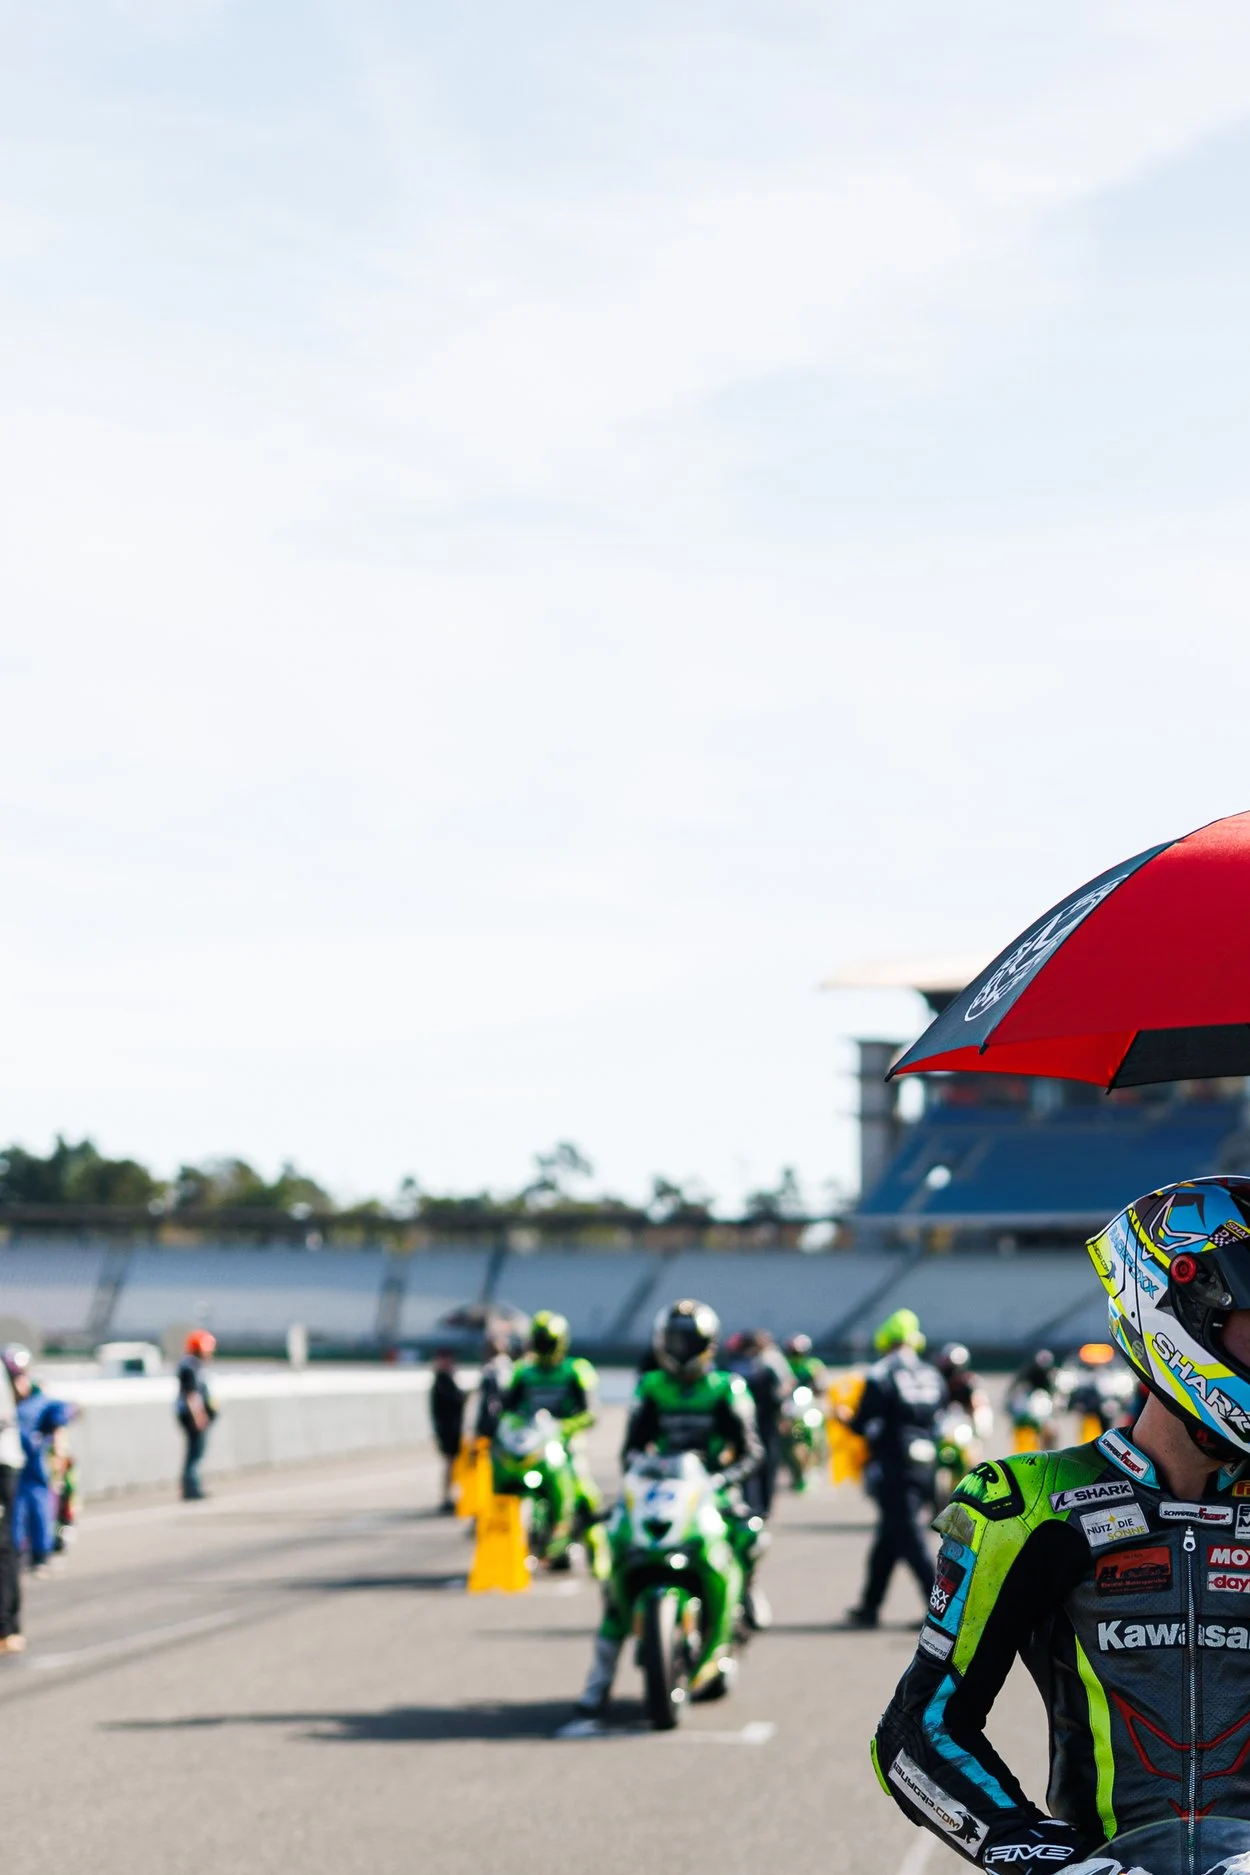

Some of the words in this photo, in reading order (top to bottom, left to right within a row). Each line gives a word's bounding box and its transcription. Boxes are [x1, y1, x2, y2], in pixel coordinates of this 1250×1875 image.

[1074, 1484, 1132, 1501] SHARK
[1087, 1524, 1111, 1536] NUTZ
[1118, 1518, 1134, 1529] DIE
[1107, 1527, 1145, 1541] SONNE
[984, 1844, 1075, 1864] FIVE
